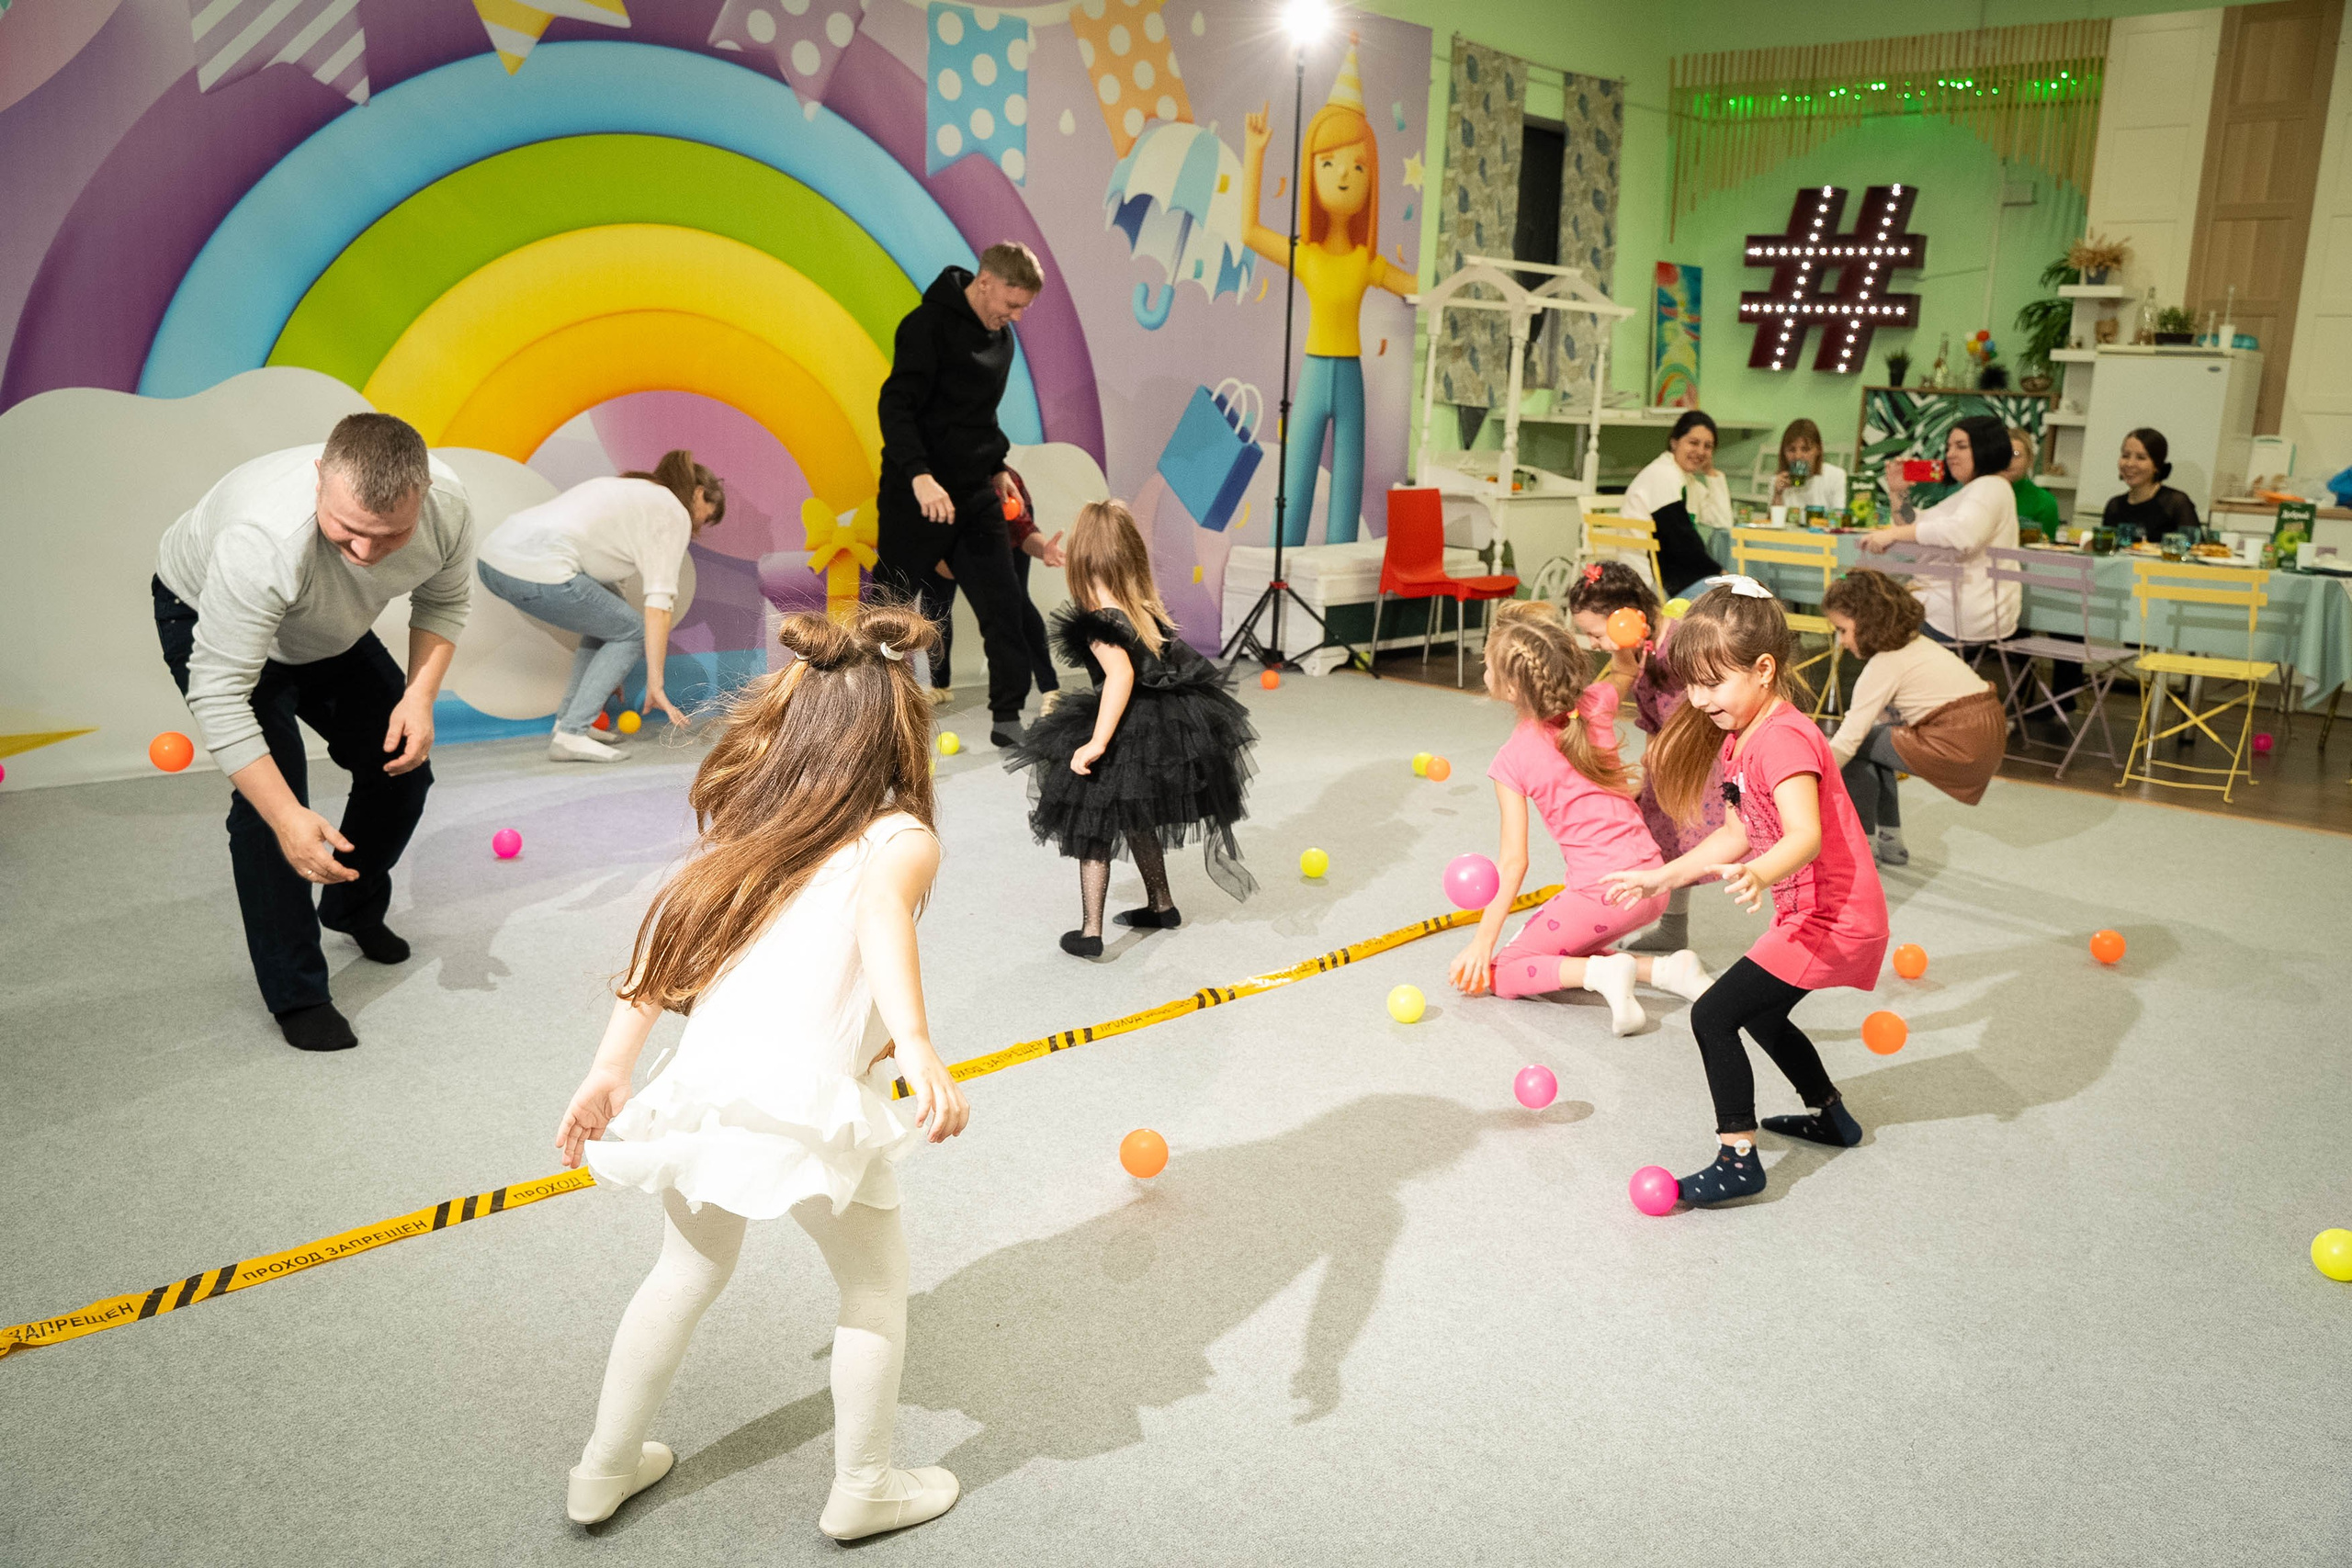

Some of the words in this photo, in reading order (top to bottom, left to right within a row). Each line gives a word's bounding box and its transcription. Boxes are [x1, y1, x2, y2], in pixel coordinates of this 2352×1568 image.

[949, 1066, 984, 1079] ОХОД
[982, 1040, 1045, 1068] ЗАПРЕЩЕН
[514, 1177, 583, 1201] ПРОХОД
[243, 1252, 324, 1280] ПРОХОД
[325, 1220, 427, 1256] ЗАПРЕЩЕН
[9, 1303, 134, 1342] ЗАПРЕЩЕН
